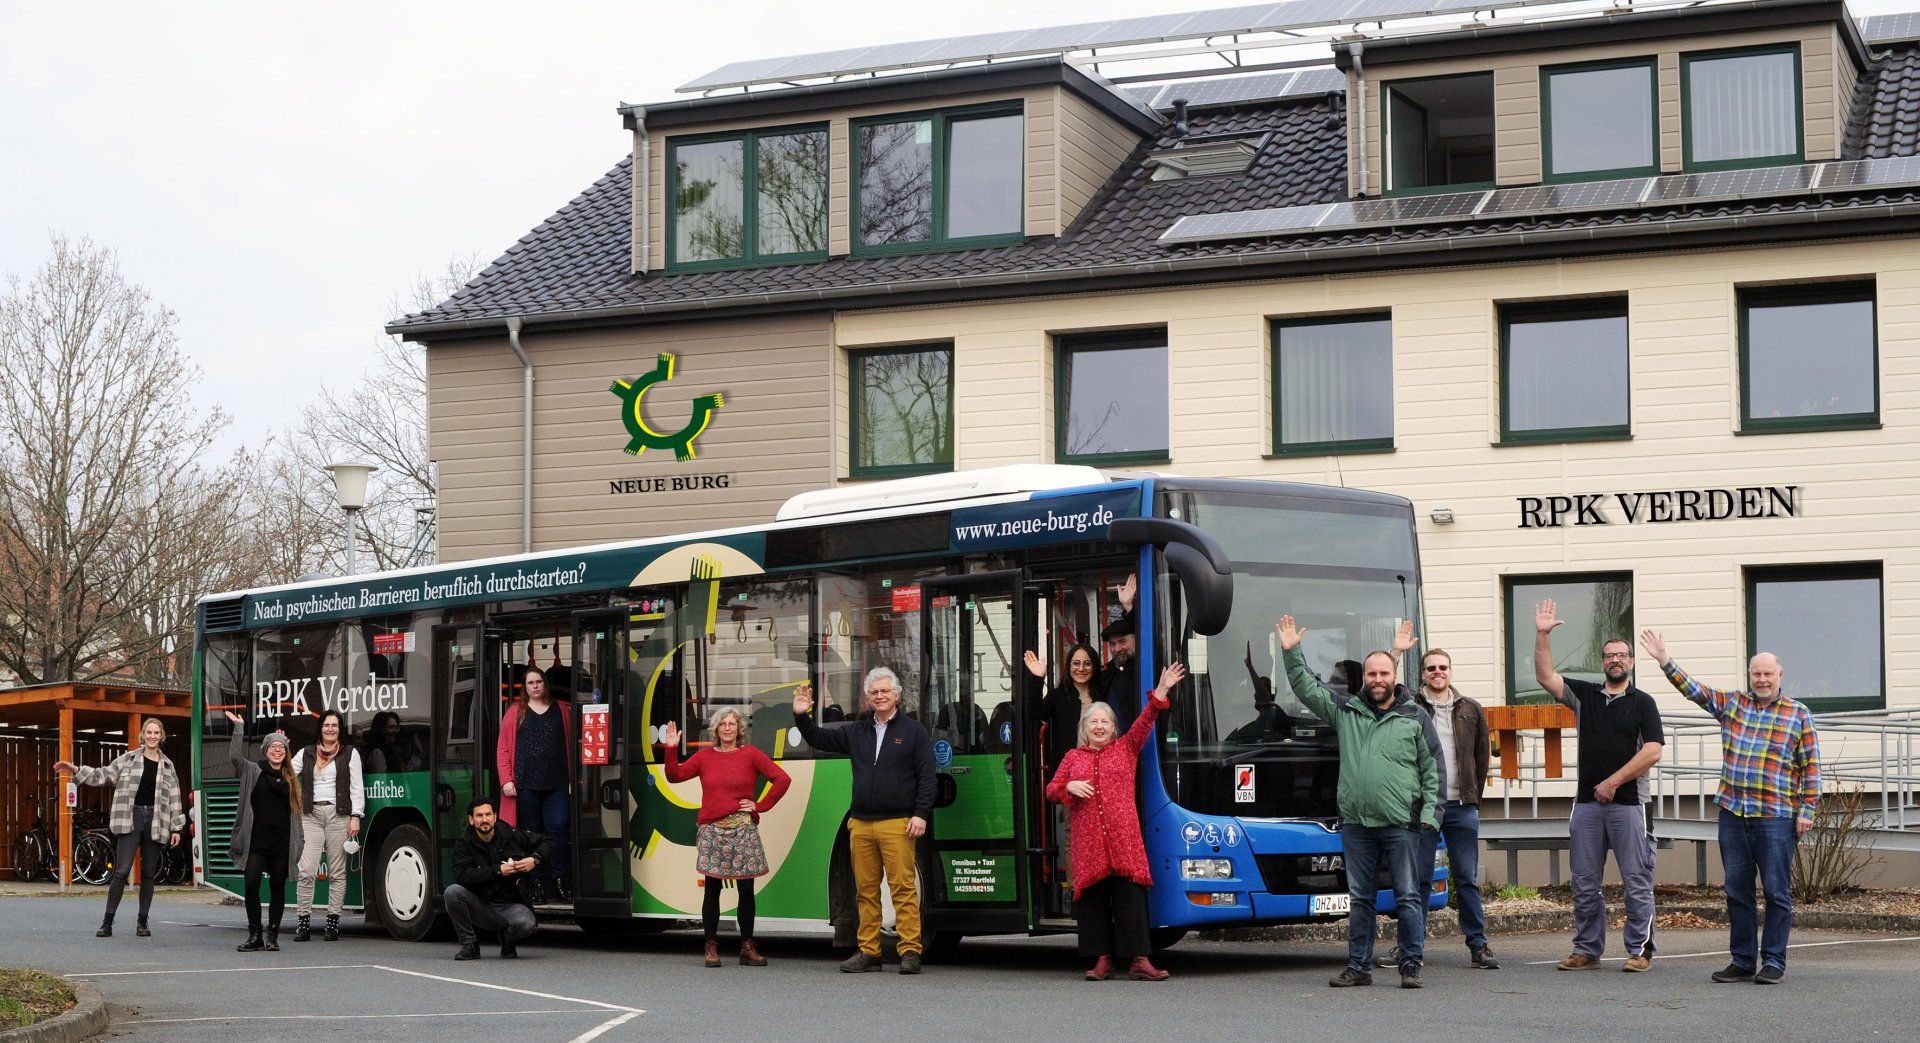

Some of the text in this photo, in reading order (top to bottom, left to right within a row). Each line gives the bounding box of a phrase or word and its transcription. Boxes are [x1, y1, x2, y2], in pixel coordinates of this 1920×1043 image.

[609, 475, 730, 494] NEUE BURG
[1516, 486, 1797, 528] RPK VERDEN
[956, 505, 1113, 541] www.neue-burg.de
[253, 561, 587, 621] Nach psychischen Barrieren beruflich durchstarten?
[256, 672, 409, 719] RPK Verden
[1236, 791, 1254, 801] VBN
[982, 858, 995, 866] Taxi
[1311, 855, 1346, 872] MA
[963, 867, 992, 875] Kirschner
[971, 876, 996, 884] Martfeld
[1315, 896, 1349, 911] OHZ VS
